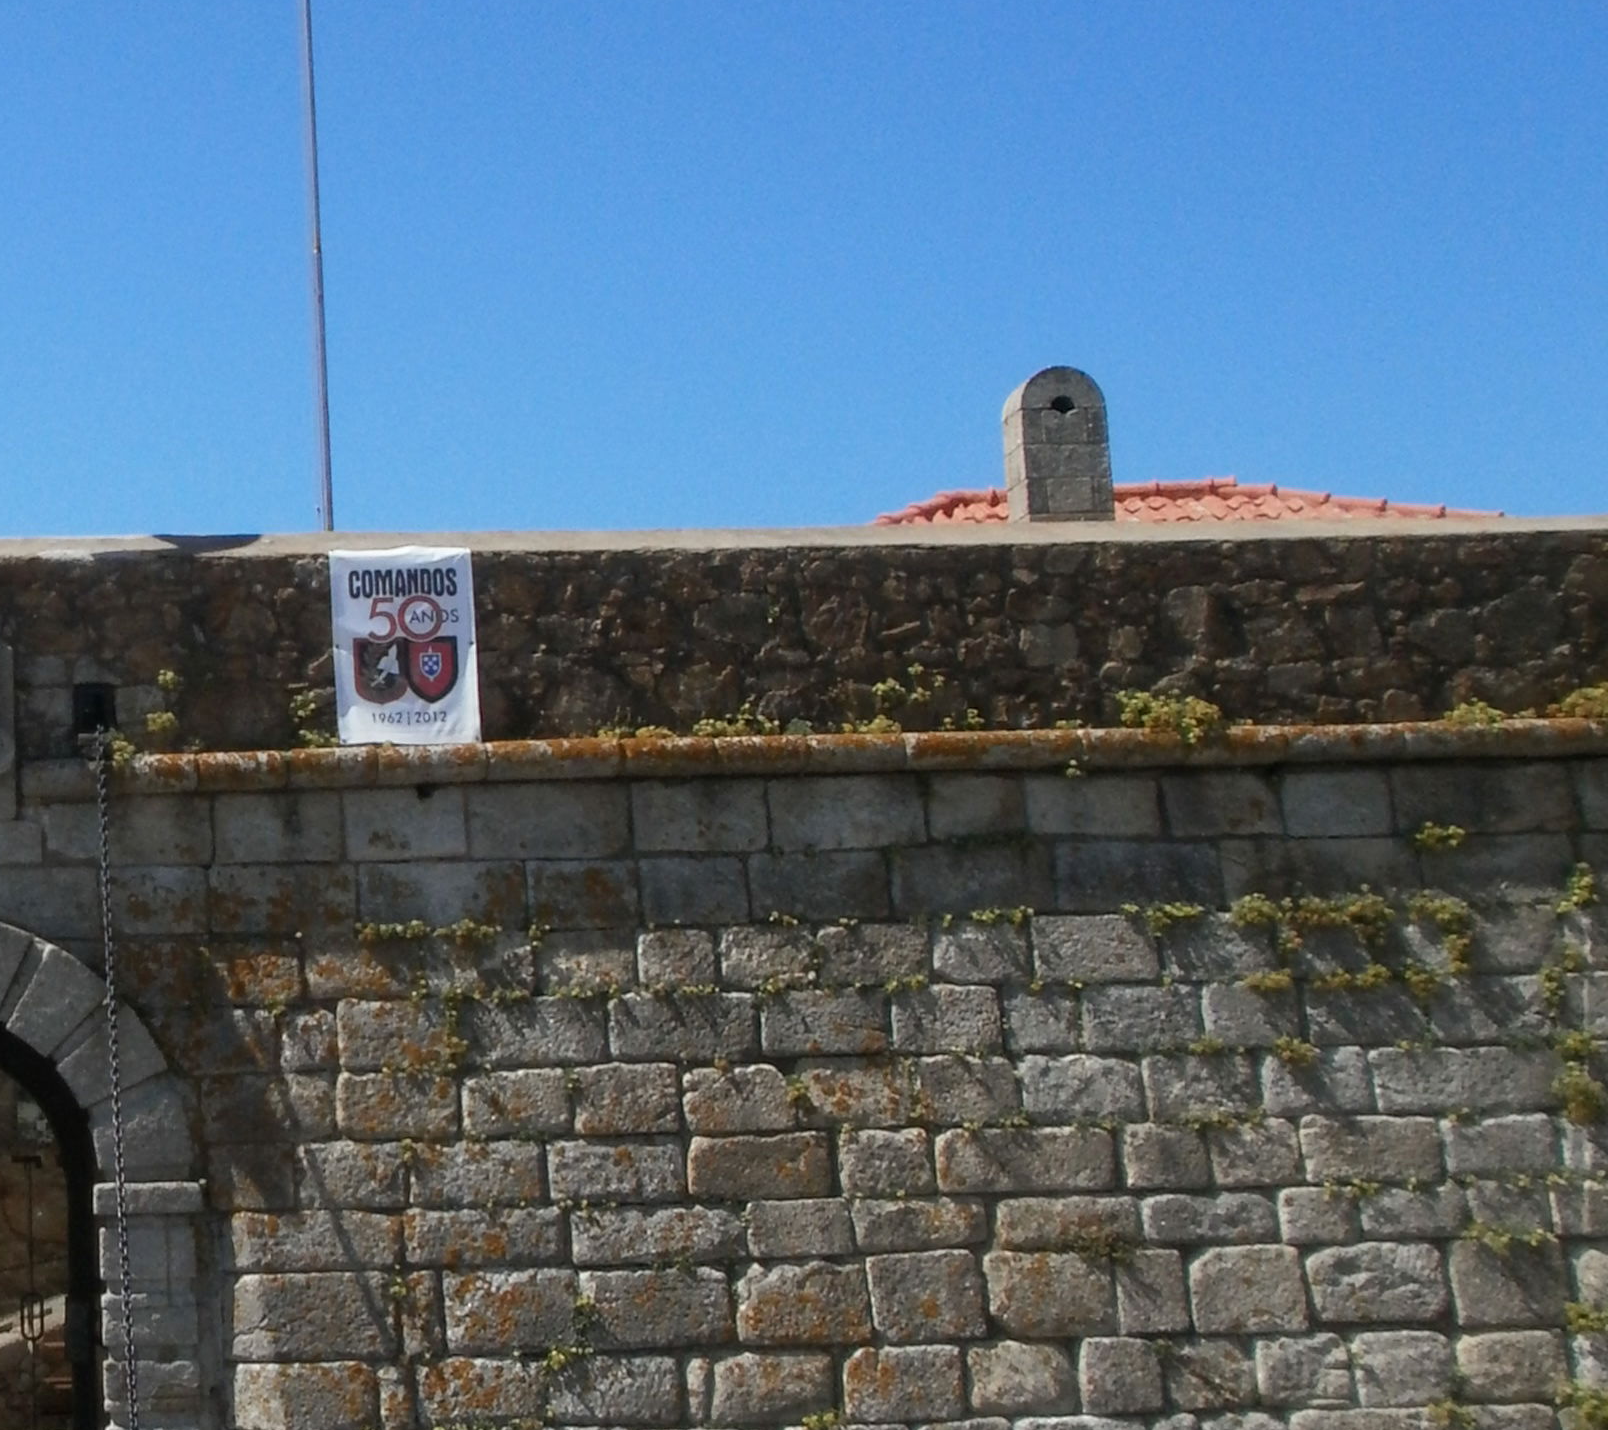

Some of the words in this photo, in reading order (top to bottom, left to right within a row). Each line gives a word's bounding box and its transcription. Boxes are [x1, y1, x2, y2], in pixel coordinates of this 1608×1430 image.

[348, 567, 457, 599] COMANDOS
[368, 596, 444, 642] 50
[409, 608, 459, 624] ANOS
